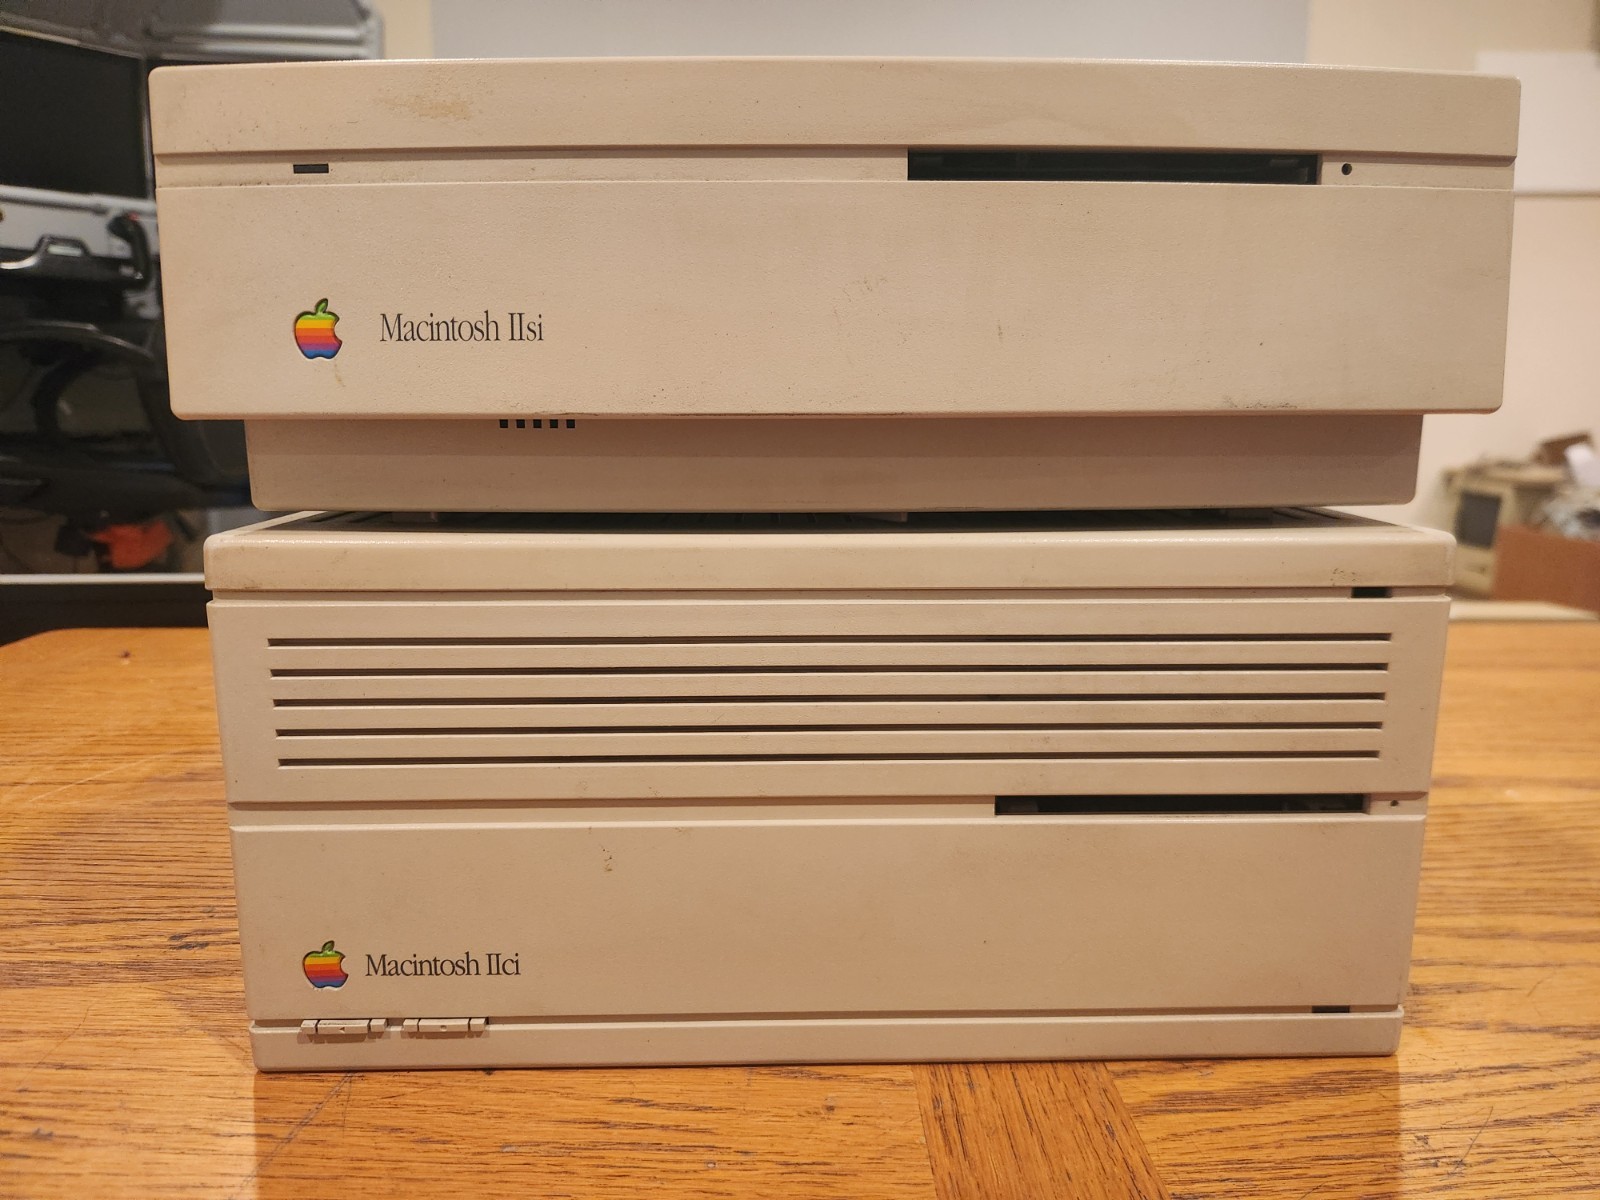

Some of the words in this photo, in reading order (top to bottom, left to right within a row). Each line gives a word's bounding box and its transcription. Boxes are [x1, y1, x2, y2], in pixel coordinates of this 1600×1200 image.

[379, 310, 501, 342] Macintosh
[508, 312, 545, 342] IIsi
[364, 951, 480, 977] Macintosh
[485, 952, 521, 976] IIci
